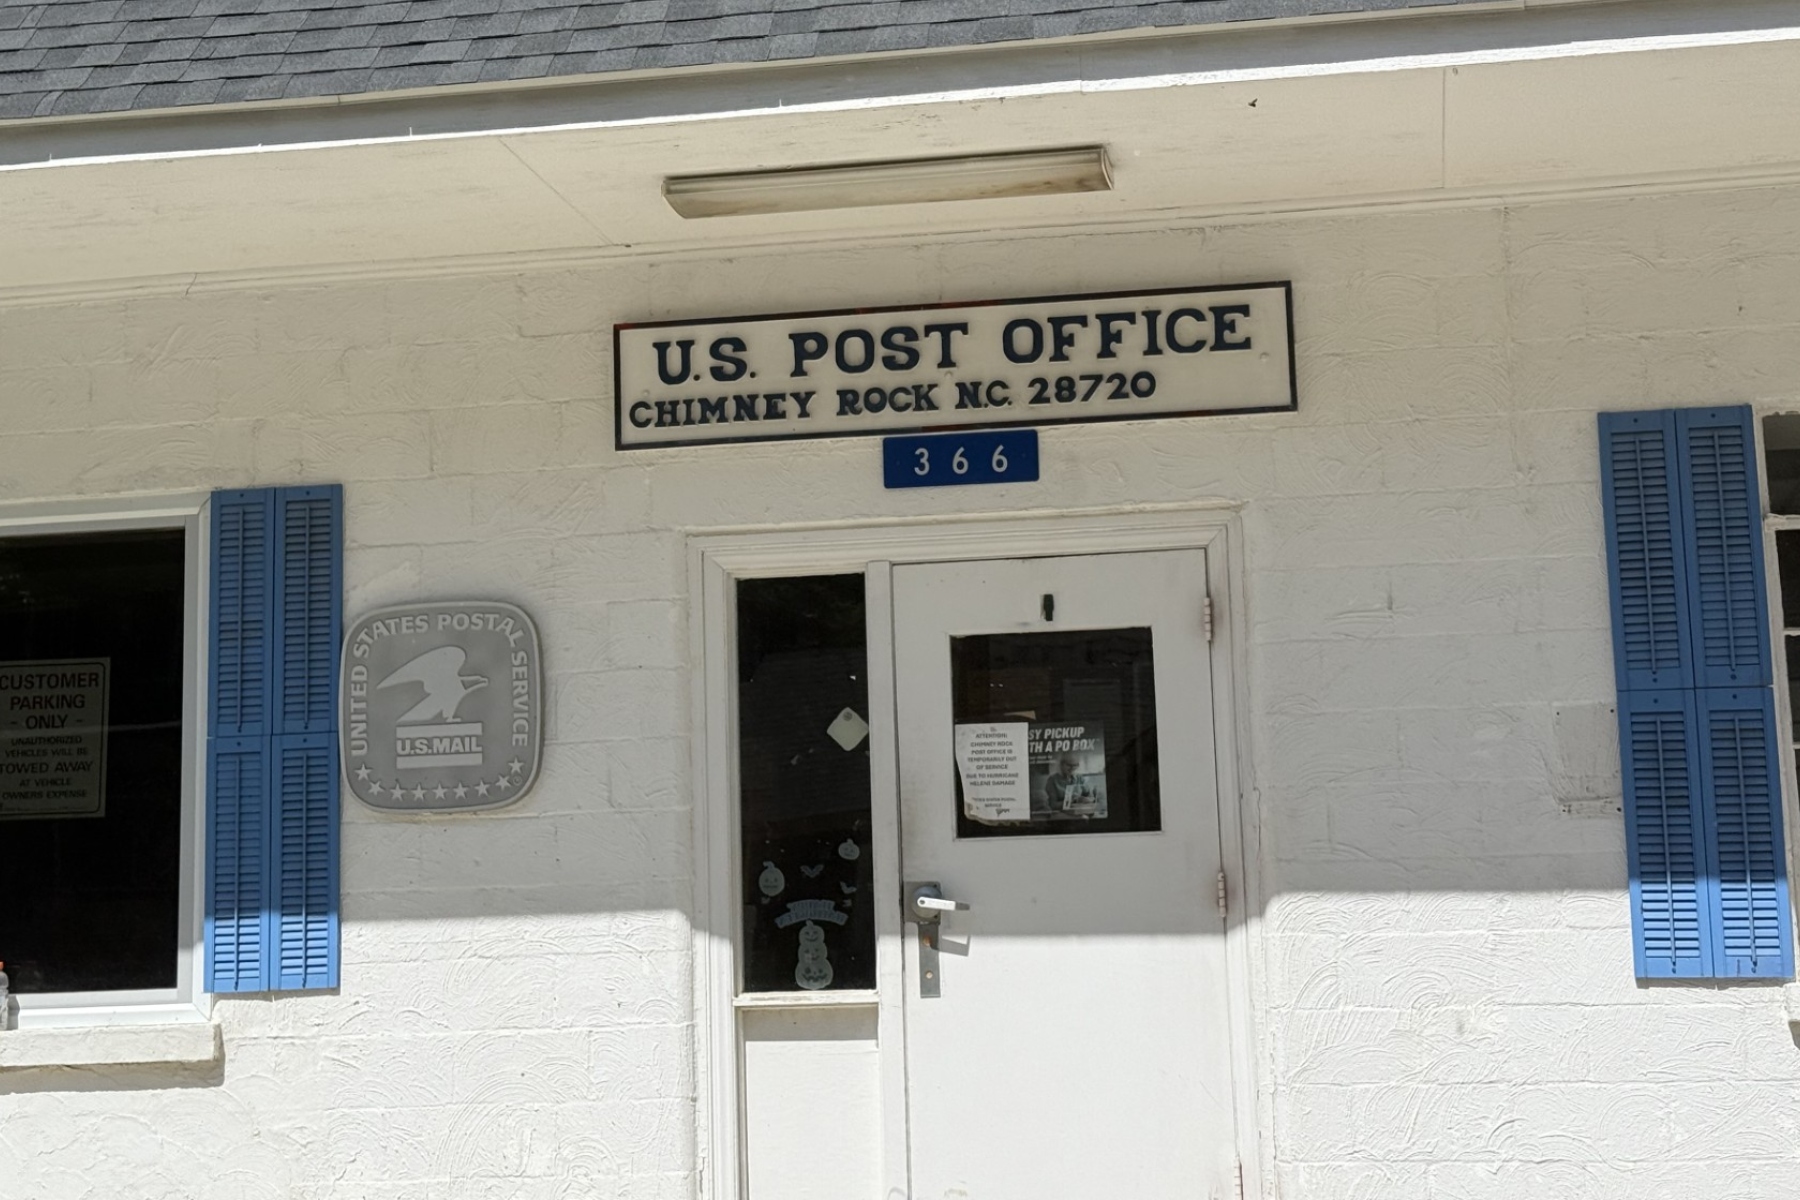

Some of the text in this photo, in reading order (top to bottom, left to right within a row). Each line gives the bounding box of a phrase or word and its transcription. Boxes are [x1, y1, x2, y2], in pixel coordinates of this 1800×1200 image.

[652, 304, 1252, 385] U.S. POST OFFICE
[629, 371, 1157, 428] CHIMNEY ROCK N.C. 28720
[0, 672, 100, 690] CUSTOMER
[350, 613, 529, 757] UNITED STATES POSTAL SERVICE
[10, 694, 86, 710] PARKING
[1044, 726, 1085, 740] PICKUP
[11, 735, 82, 746] UNAUTHORIZED
[1044, 741, 1053, 753] A
[1055, 739, 1070, 752] PO
[1072, 738, 1096, 751] BOX
[5, 747, 88, 758] VEHICLES WILL BE
[0, 761, 94, 774] TOWED AWAY
[19, 778, 72, 788] AT VEHICLE
[2, 789, 88, 800] OWNERS EXPENSE
